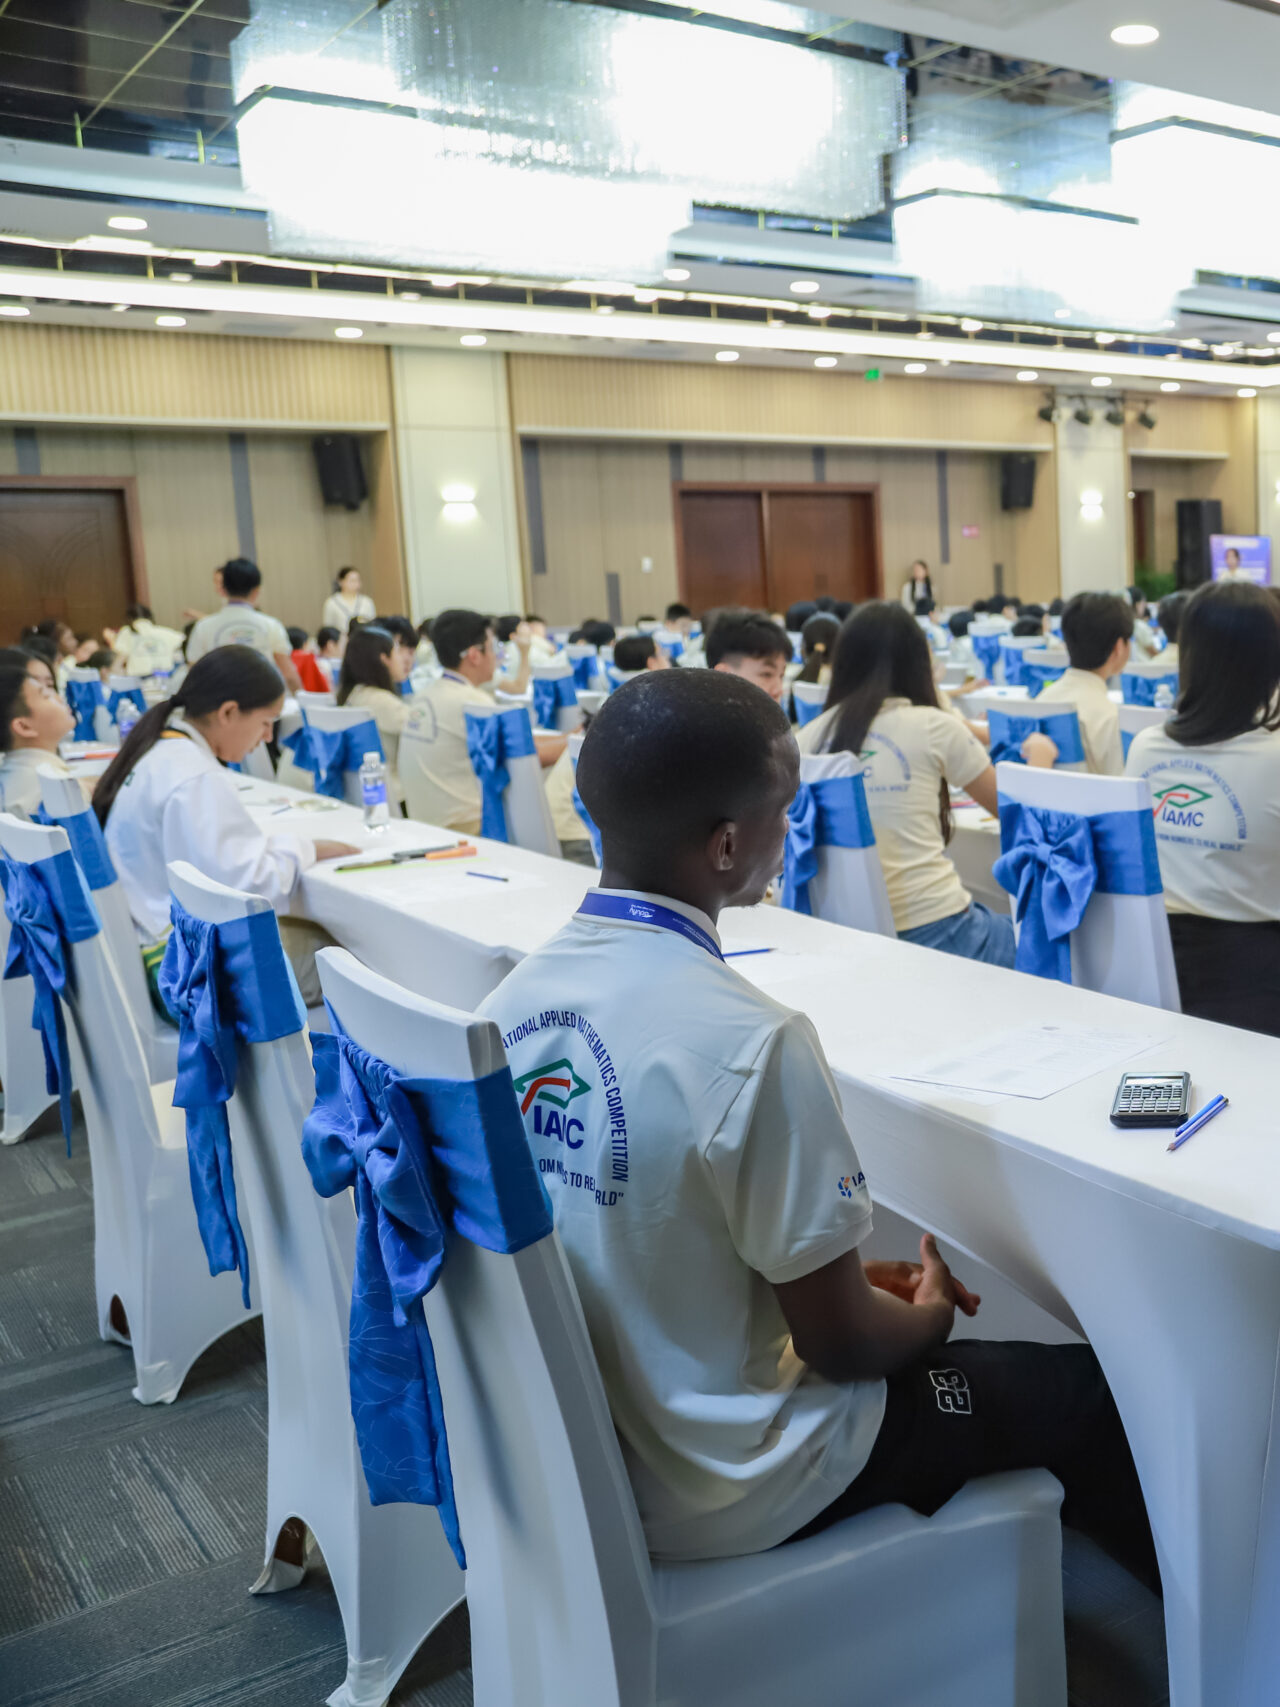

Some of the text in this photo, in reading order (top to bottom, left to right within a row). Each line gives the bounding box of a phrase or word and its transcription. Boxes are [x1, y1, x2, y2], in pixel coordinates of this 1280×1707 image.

[1162, 806, 1204, 828] IAMC
[540, 1010, 577, 1029] APPLIED
[577, 1015, 617, 1088] MATHEMATICS
[605, 1086, 629, 1182] COMPETITION
[534, 1105, 585, 1150] IAC
[570, 1172, 583, 1188] TO
